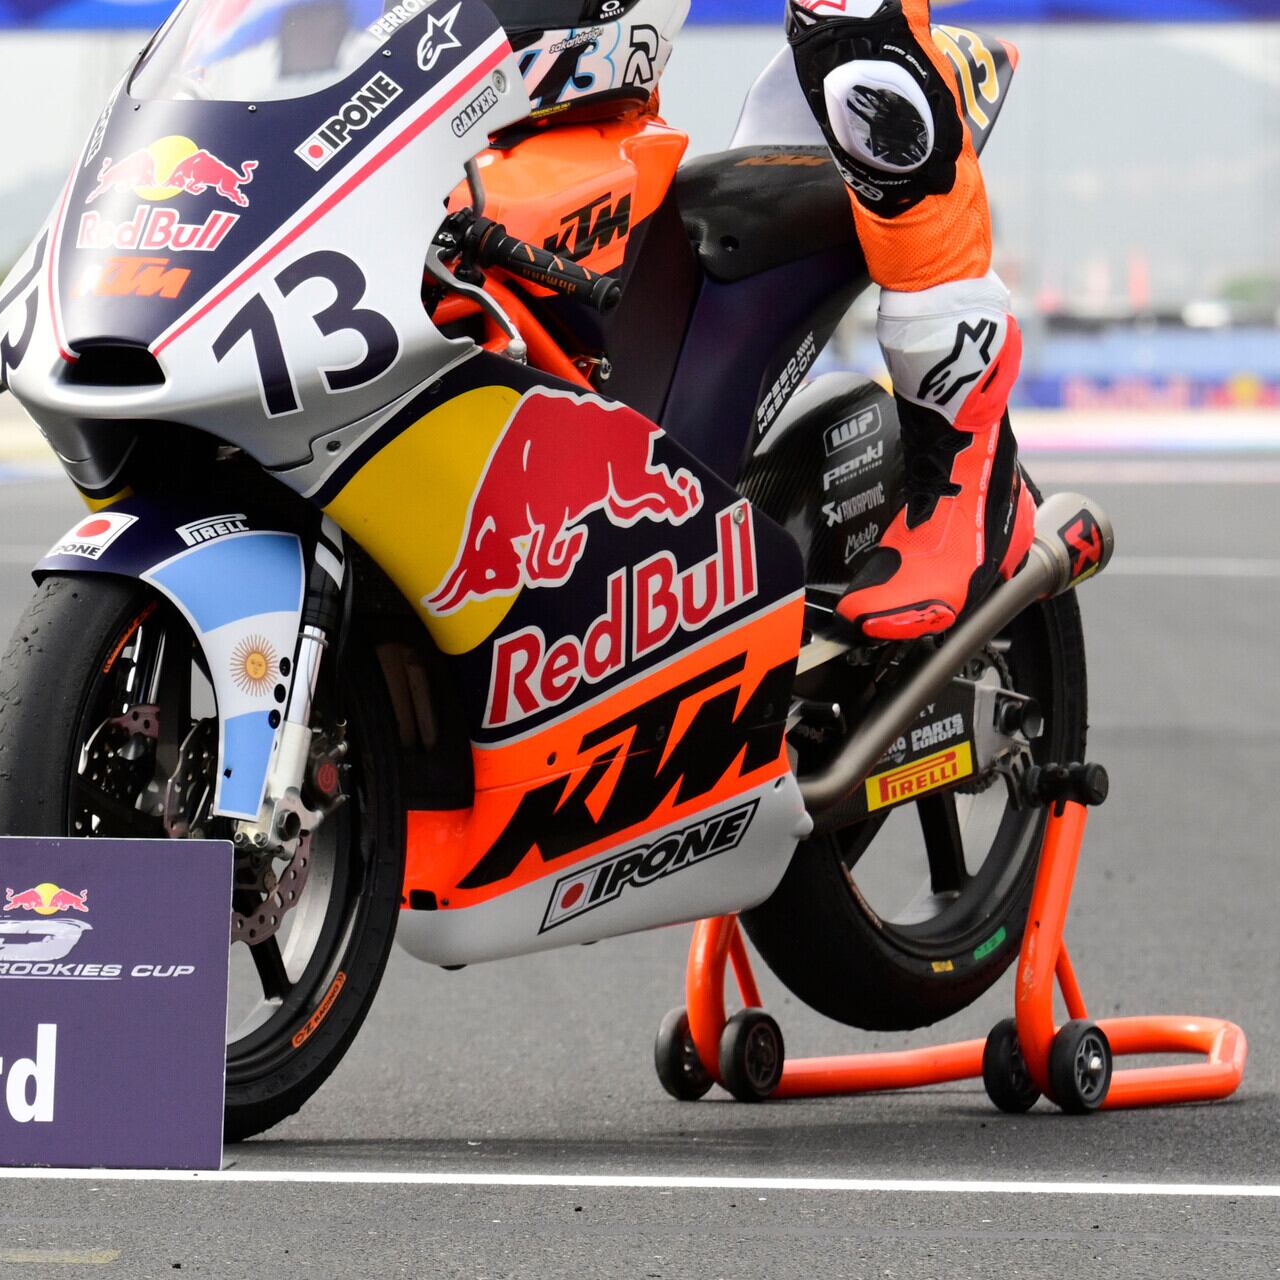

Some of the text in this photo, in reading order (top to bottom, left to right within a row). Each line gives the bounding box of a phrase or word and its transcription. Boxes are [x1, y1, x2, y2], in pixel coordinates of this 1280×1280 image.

[600, 7, 625, 19] OAKLEY
[317, 75, 398, 151] IPONE
[451, 86, 498, 138] GALFER
[78, 206, 237, 250] Red Bull
[542, 191, 632, 262] KTM
[70, 256, 193, 299] KTM
[757, 357, 797, 422] SPEED
[758, 343, 816, 434] WEEK.COM
[831, 410, 874, 448] WP
[487, 500, 756, 726] Red Bull
[911, 713, 964, 742] PARTS
[912, 728, 965, 752] EUROPE
[456, 650, 798, 890] KTM
[878, 751, 958, 803] PIRELLI
[588, 814, 750, 902] IPONE
[130, 965, 195, 977] CUP
